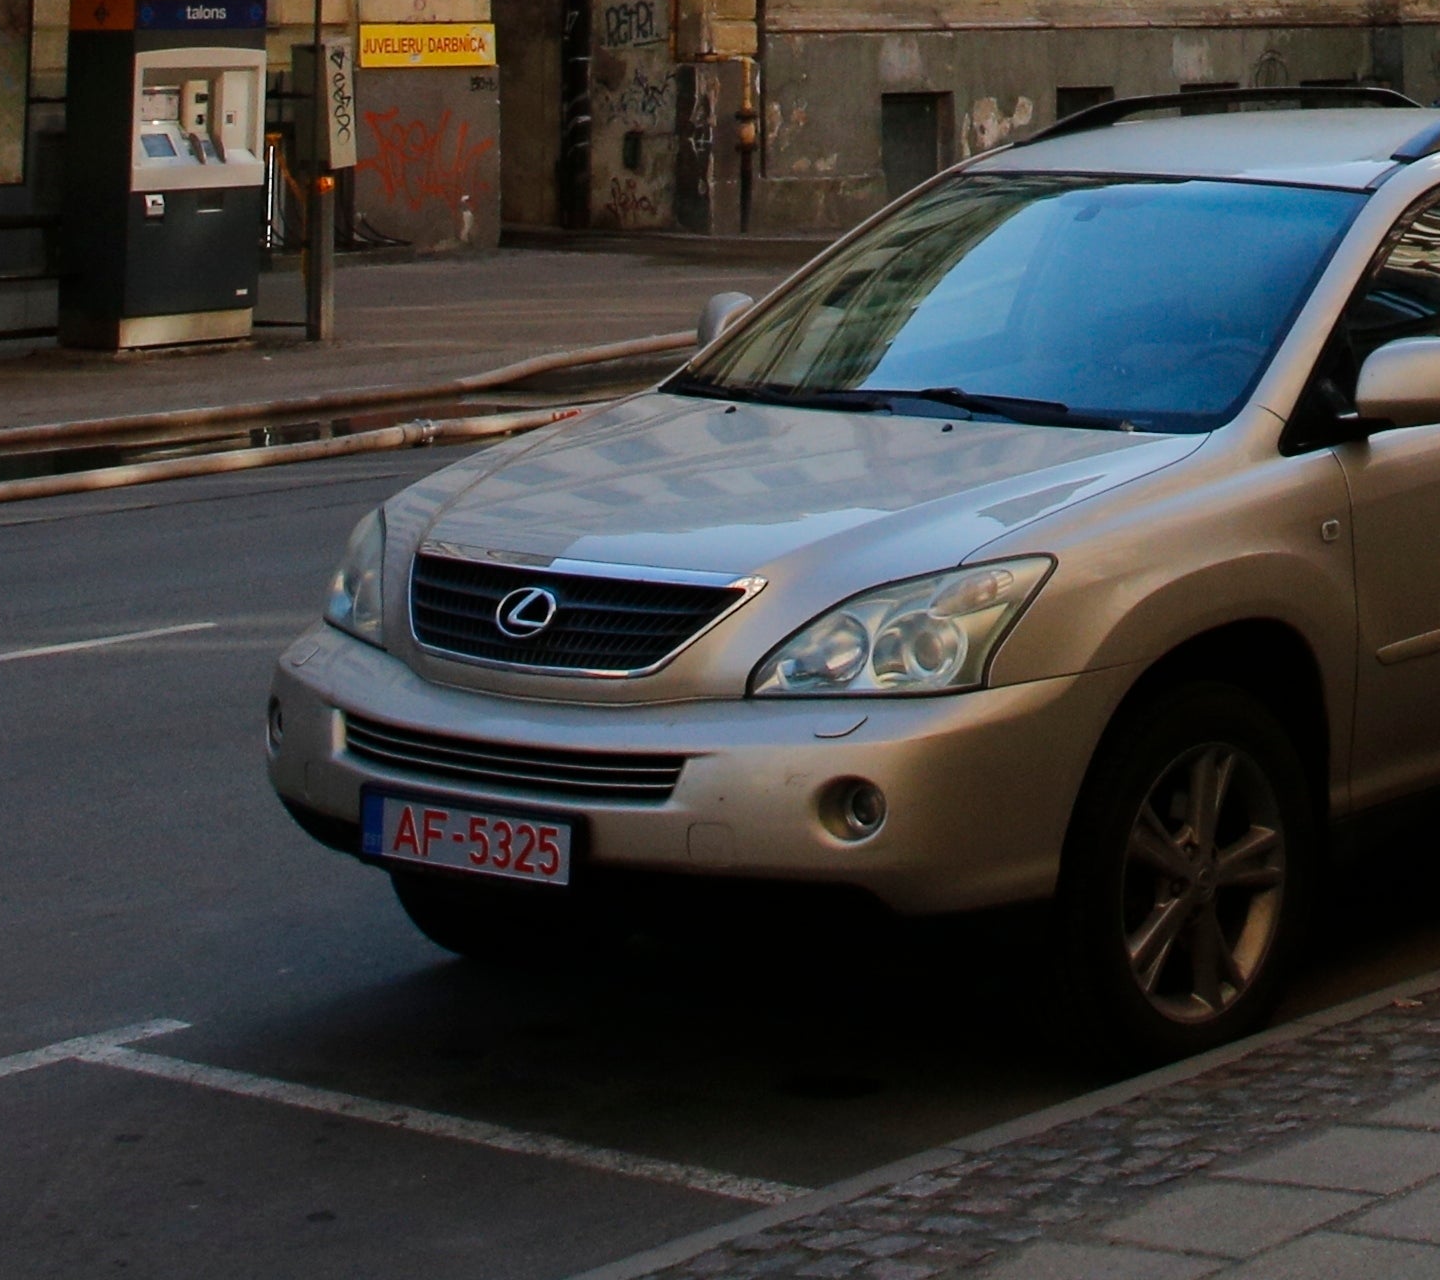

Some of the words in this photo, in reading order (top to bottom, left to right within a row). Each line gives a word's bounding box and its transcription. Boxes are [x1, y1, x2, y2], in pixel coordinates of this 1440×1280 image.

[186, 5, 226, 20] talons
[362, 38, 424, 55] JUVELIERU
[428, 35, 486, 53] DARBNĪCA
[392, 804, 560, 877] AF-5325
